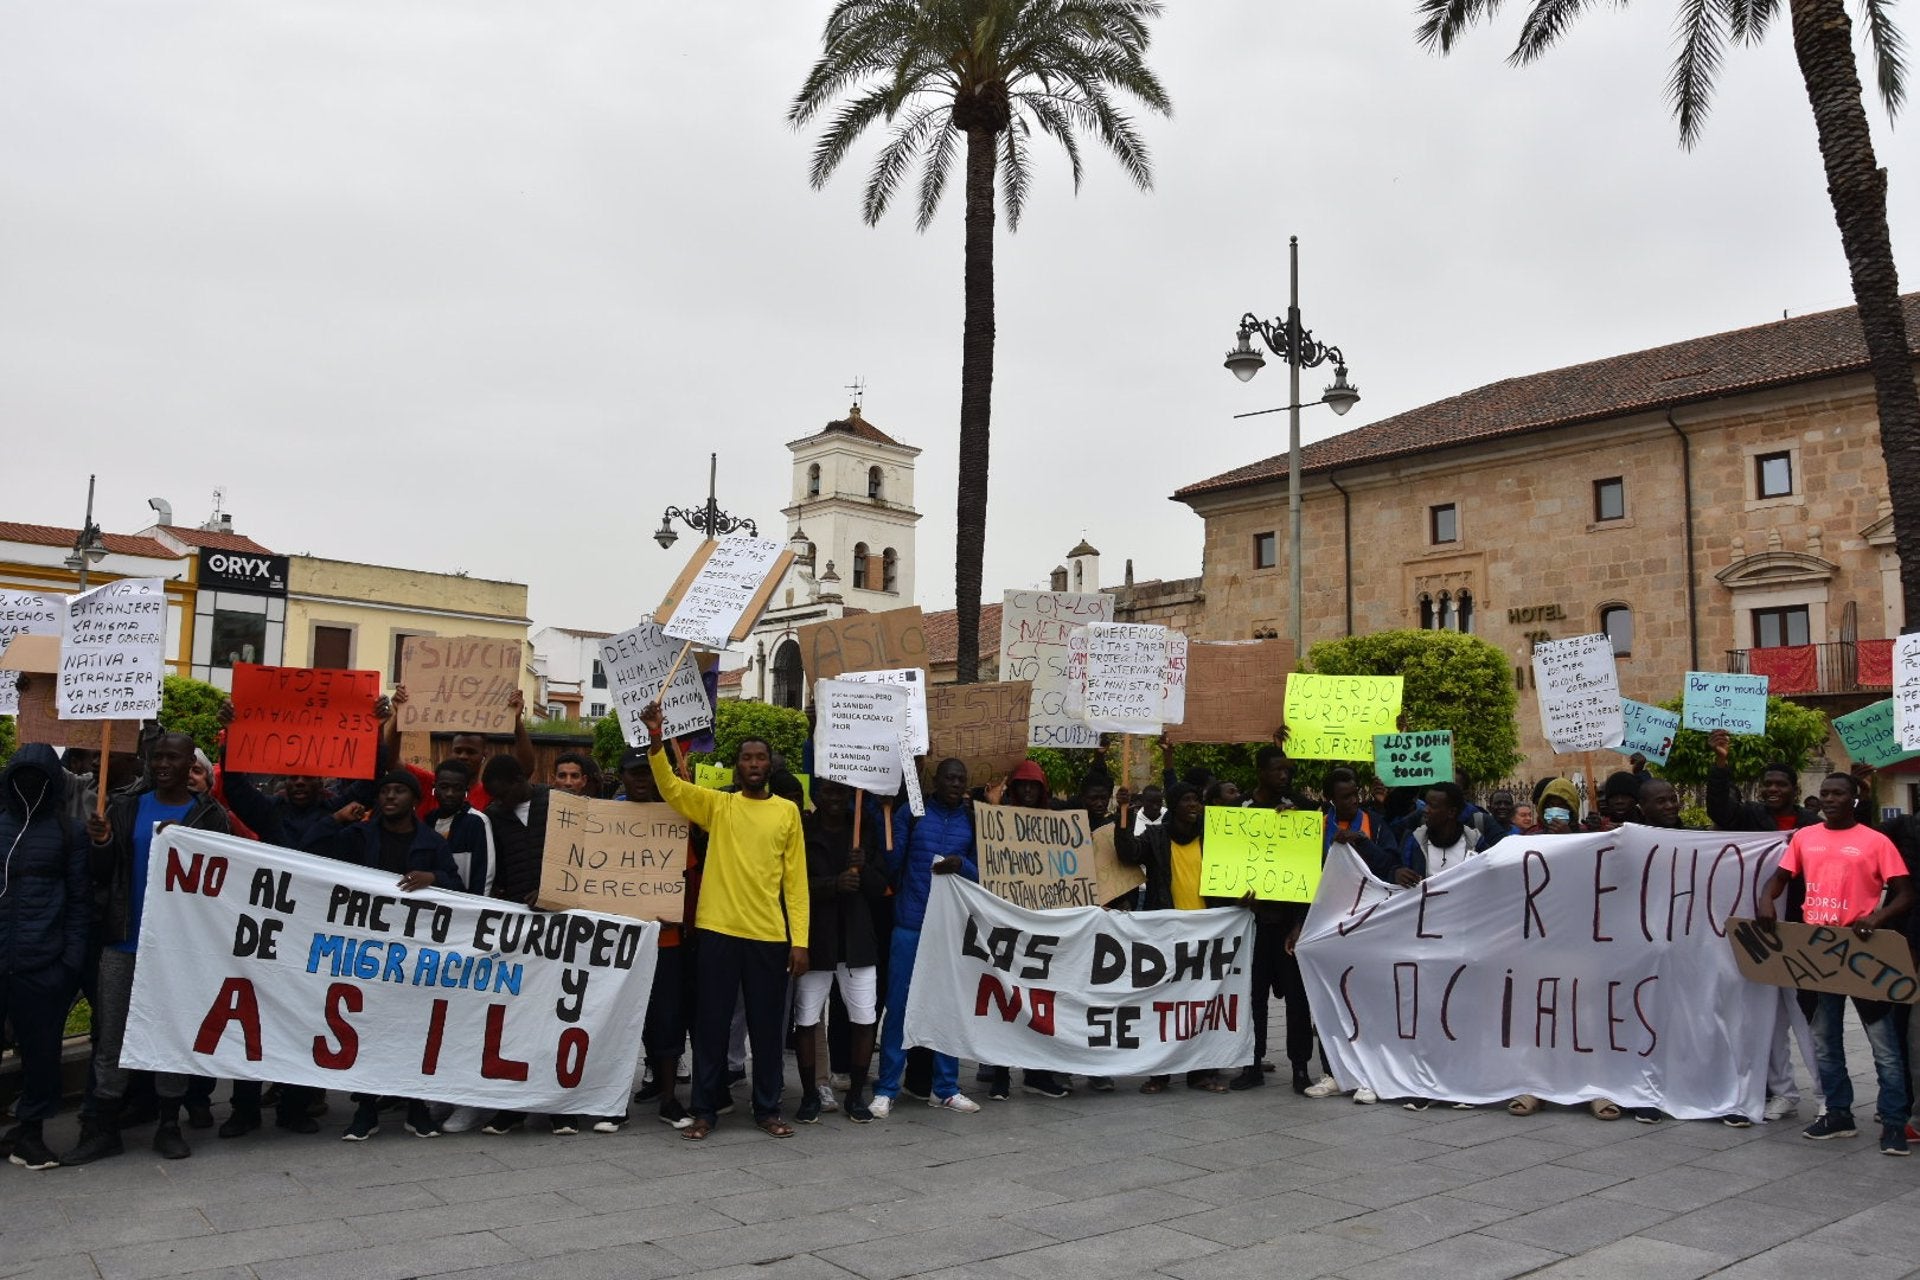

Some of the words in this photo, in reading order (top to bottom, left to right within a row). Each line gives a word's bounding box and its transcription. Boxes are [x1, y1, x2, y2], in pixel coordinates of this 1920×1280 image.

[208, 554, 271, 578] ORYX
[14, 596, 44, 607] LOS
[71, 602, 160, 617] EXTRANJERA
[1507, 604, 1567, 624] HOTEL
[94, 620, 139, 630] MISMA
[1094, 626, 1165, 640] QUEREMOS
[73, 634, 113, 644] CLASE
[118, 633, 160, 645] OBRERA
[1090, 640, 1130, 652] CITAS
[1136, 641, 1164, 652] PARA
[1583, 635, 1606, 646] CASA
[813, 622, 926, 678] ASILO
[1542, 656, 1555, 665] ES
[1557, 649, 1579, 660] IRSE
[64, 652, 124, 670] NATIVA
[1009, 656, 1040, 682] NO
[64, 672, 153, 685] EXTRANJERA
[256, 668, 375, 698] ILEGAL
[1089, 679, 1100, 689] EL
[1104, 680, 1160, 691] MINISTRO
[1576, 672, 1587, 680] EL
[88, 687, 134, 699] MISMA
[1288, 675, 1395, 702] ACUERDO
[1690, 677, 1709, 692] Por
[1715, 684, 1730, 693] un
[1734, 682, 1767, 696] mundo
[842, 702, 874, 710] SANIDAD
[875, 693, 892, 701] PERO
[1087, 692, 1144, 703] INTERIOR
[71, 702, 110, 714] CLASE
[114, 699, 156, 712] OBRERA
[1087, 705, 1151, 718] RACISMO
[1289, 703, 1390, 725] EUROPEO
[243, 707, 323, 727] HUMANO
[338, 712, 375, 732] SER
[881, 715, 894, 723] VEZ
[1586, 721, 1606, 730] FROM
[1647, 714, 1678, 731] unida
[1834, 721, 1854, 736] Por
[1861, 714, 1881, 726] una
[1636, 722, 1647, 735] la
[1383, 734, 1413, 750] LOS
[1416, 734, 1451, 748] DDHH
[840, 753, 871, 761] SANIDAD
[1392, 765, 1434, 778] tocan
[980, 808, 1005, 842] LOS
[1208, 810, 1321, 840] VERGUENZA
[568, 843, 608, 869] NO
[621, 848, 674, 870] HAY
[1248, 841, 1277, 862] DE
[985, 844, 1044, 876] HUMANOS
[1048, 848, 1077, 878] NO
[556, 869, 685, 898] DERECHOS
[1208, 864, 1308, 898] EUROPA
[1806, 882, 1819, 892] TU
[165, 847, 229, 898] NO
[249, 867, 297, 915] AL
[326, 884, 453, 944] PACTO
[473, 908, 641, 970] EUROPEO
[962, 914, 1060, 980] LOS
[1734, 920, 1783, 964] NO
[232, 913, 285, 961] DE
[306, 932, 524, 996] MIGRACIÓN
[1808, 926, 1918, 1001] PACTO
[1782, 949, 1838, 987] AL
[974, 972, 1056, 1036] NO
[1087, 1006, 1141, 1050] SE
[1153, 994, 1238, 1042] TOCAN
[192, 976, 590, 1089] ASILO
